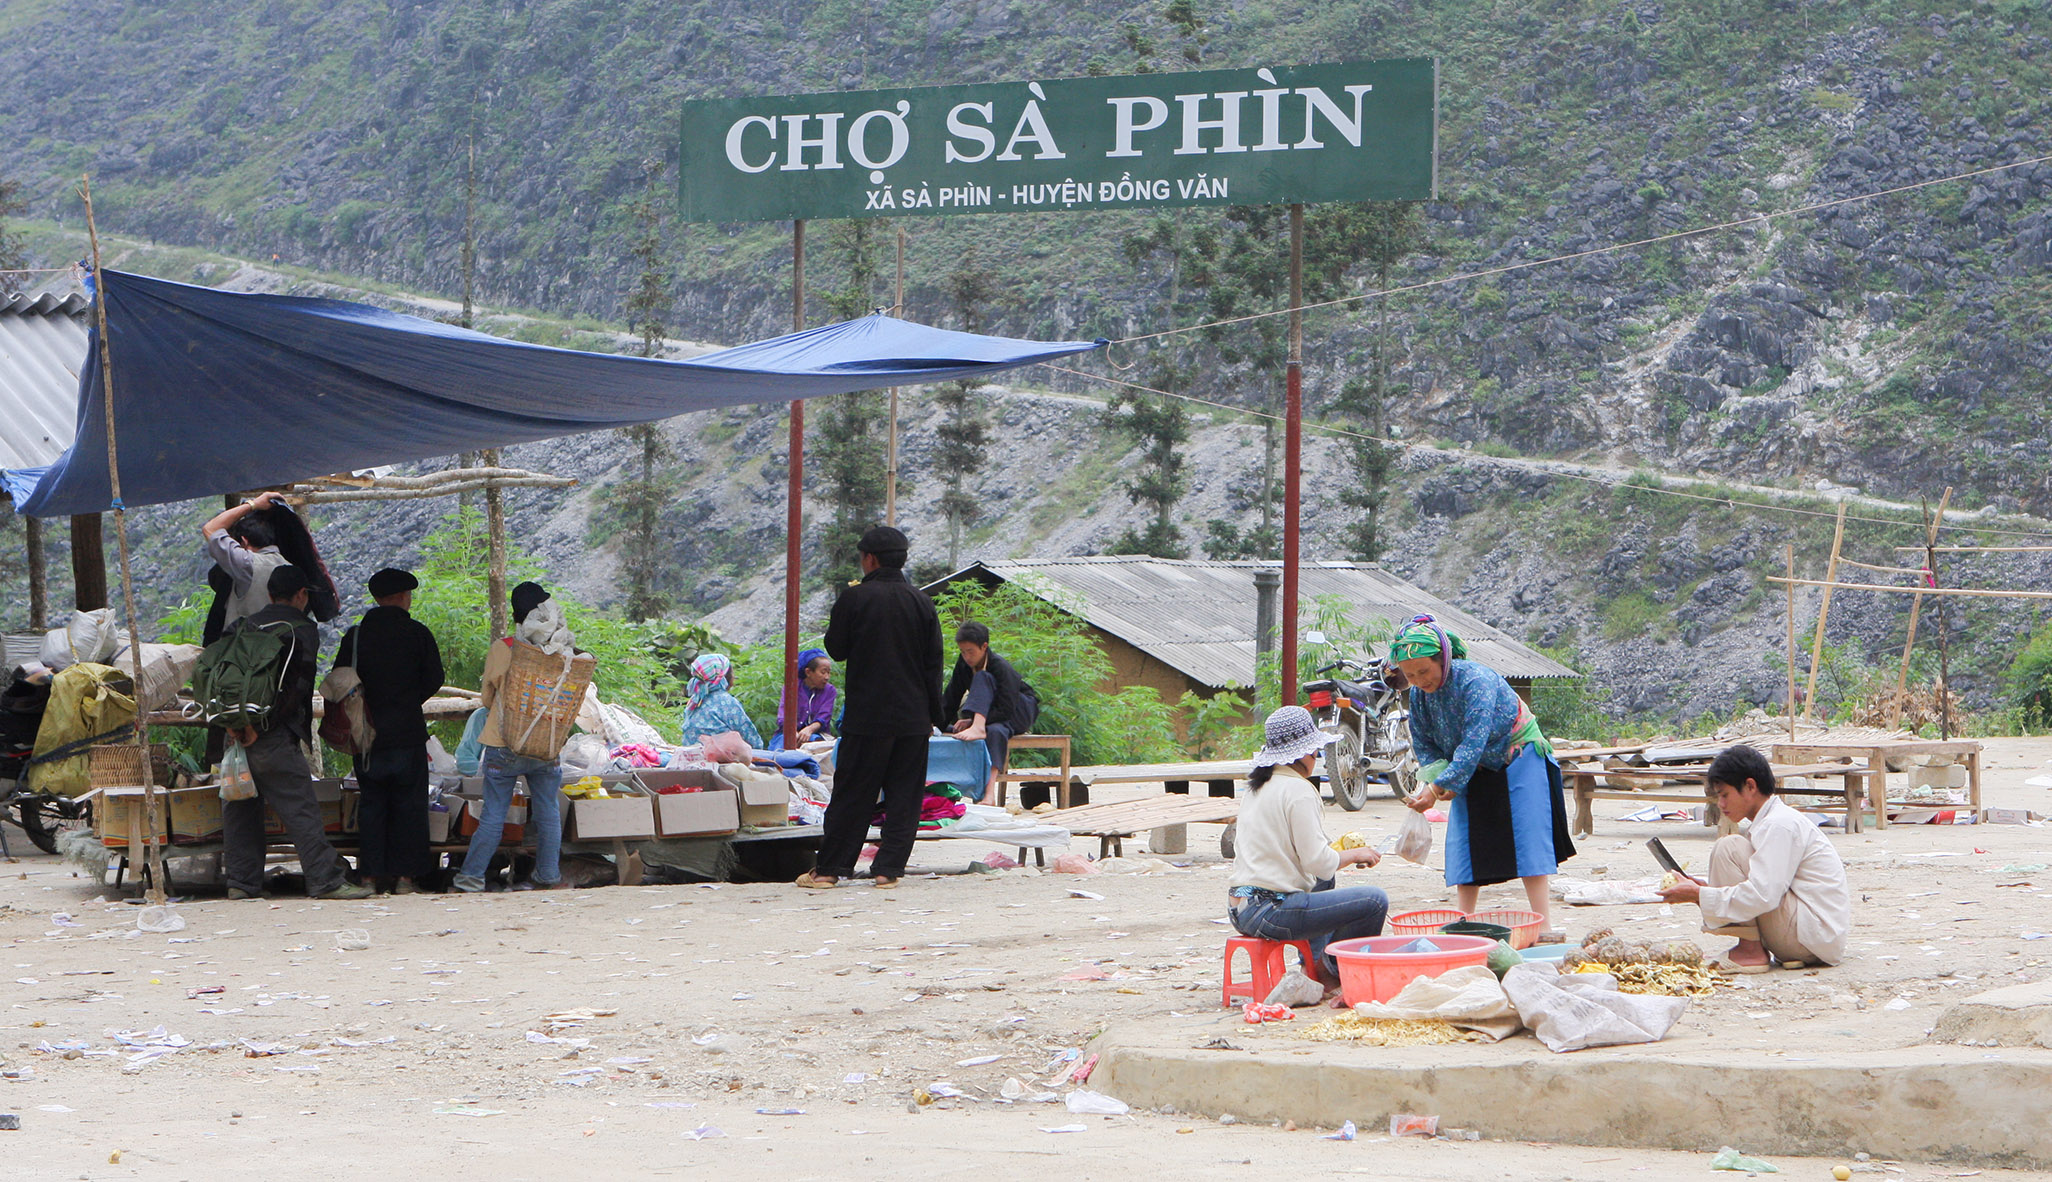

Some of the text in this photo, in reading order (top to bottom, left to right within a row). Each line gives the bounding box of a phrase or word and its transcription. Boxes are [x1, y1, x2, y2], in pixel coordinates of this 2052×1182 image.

[725, 67, 1373, 184] CHỢ SÀ PHÌN
[865, 183, 896, 210] XÃ
[902, 181, 933, 209] SÀ
[939, 181, 991, 207] PHÌN
[1013, 178, 1093, 208] HUYỆN
[1098, 171, 1170, 202] ĐỒNG
[1177, 173, 1228, 200] VĂN
